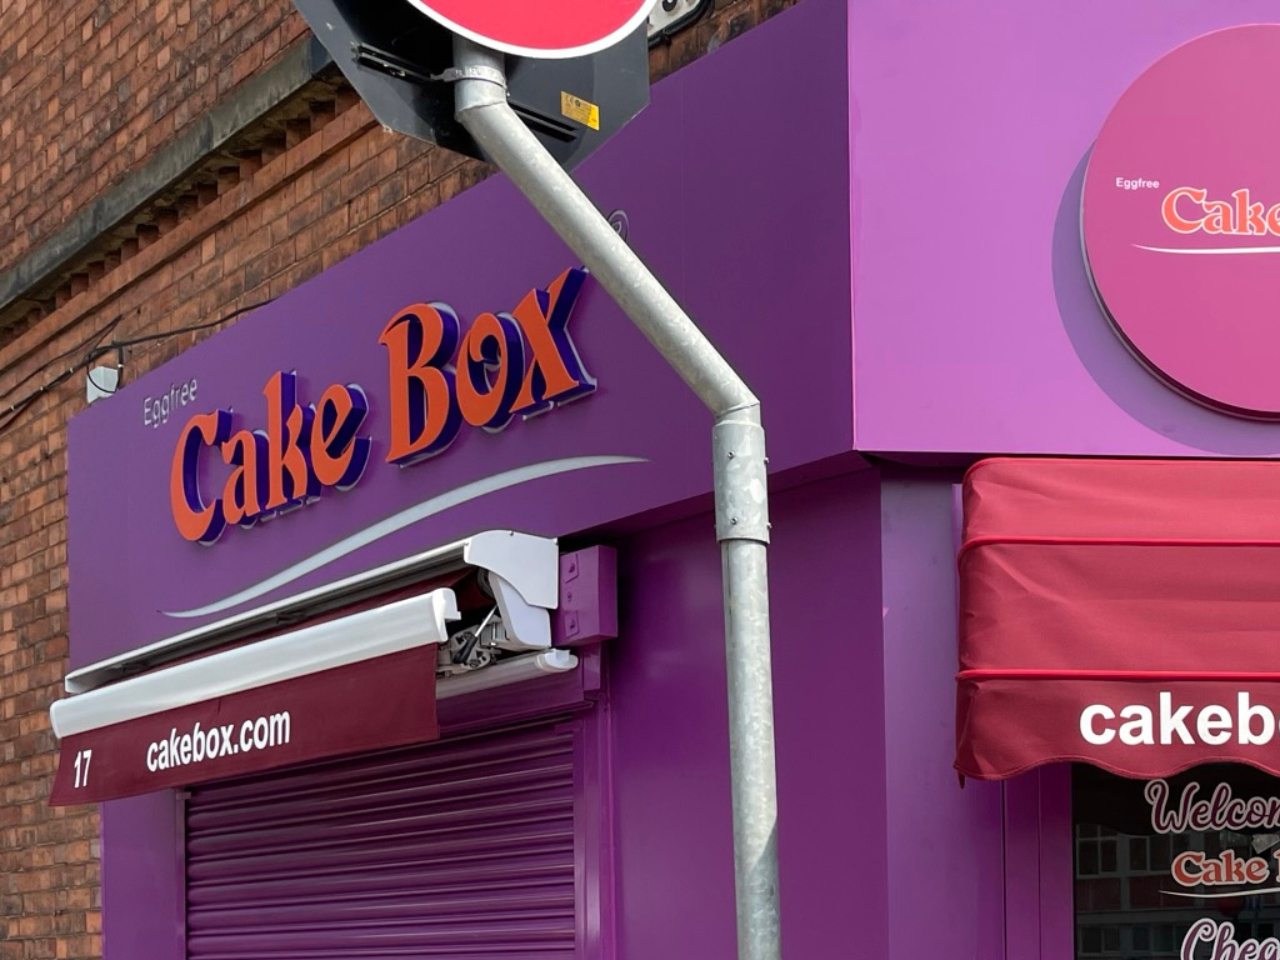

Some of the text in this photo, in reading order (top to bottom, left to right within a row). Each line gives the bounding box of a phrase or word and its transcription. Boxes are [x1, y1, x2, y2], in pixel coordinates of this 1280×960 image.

[1115, 176, 1160, 191] Eggfree
[143, 375, 198, 428] Eggfree
[169, 267, 597, 545] Cake Box
[73, 710, 291, 788] 17 cakebox.com
[1171, 848, 1269, 886] Cake
